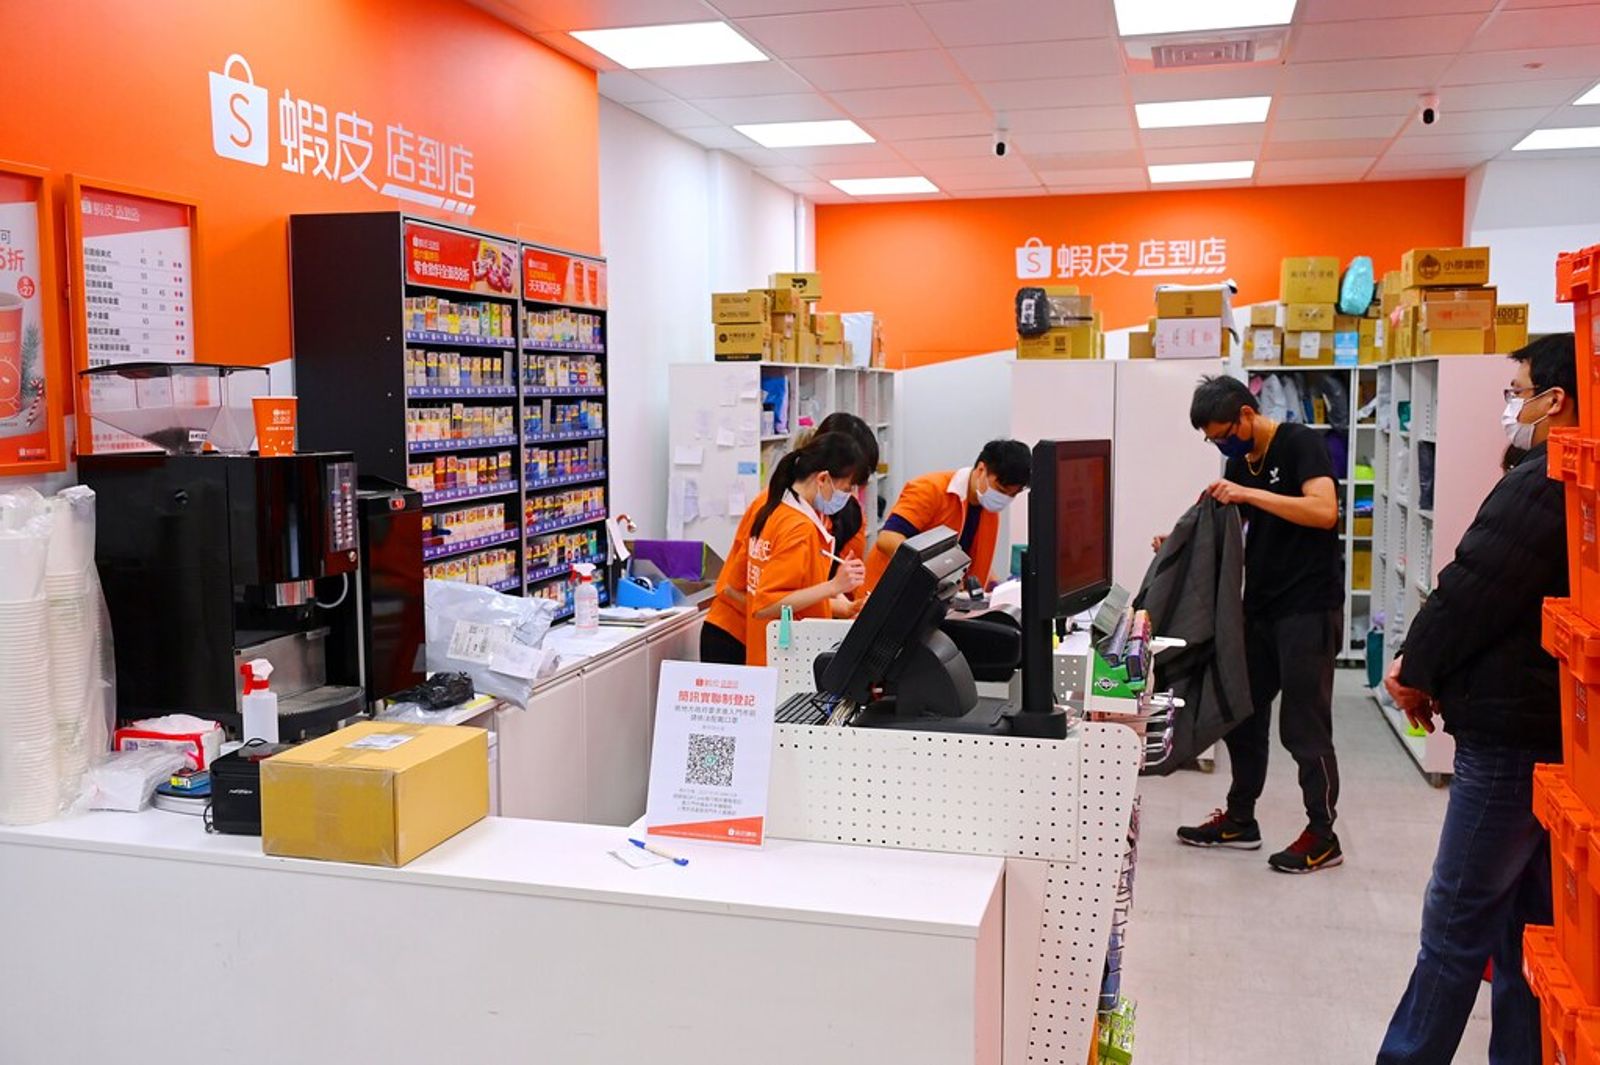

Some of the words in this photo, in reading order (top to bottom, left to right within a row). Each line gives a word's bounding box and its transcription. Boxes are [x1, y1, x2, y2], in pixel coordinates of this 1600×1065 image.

[278, 88, 378, 192] 蝦皮
[386, 122, 475, 199] 店到店
[1057, 243, 1130, 278] 蝦皮
[1138, 238, 1226, 267] 店到店
[678, 690, 755, 706] 簡訊實聯制登記
